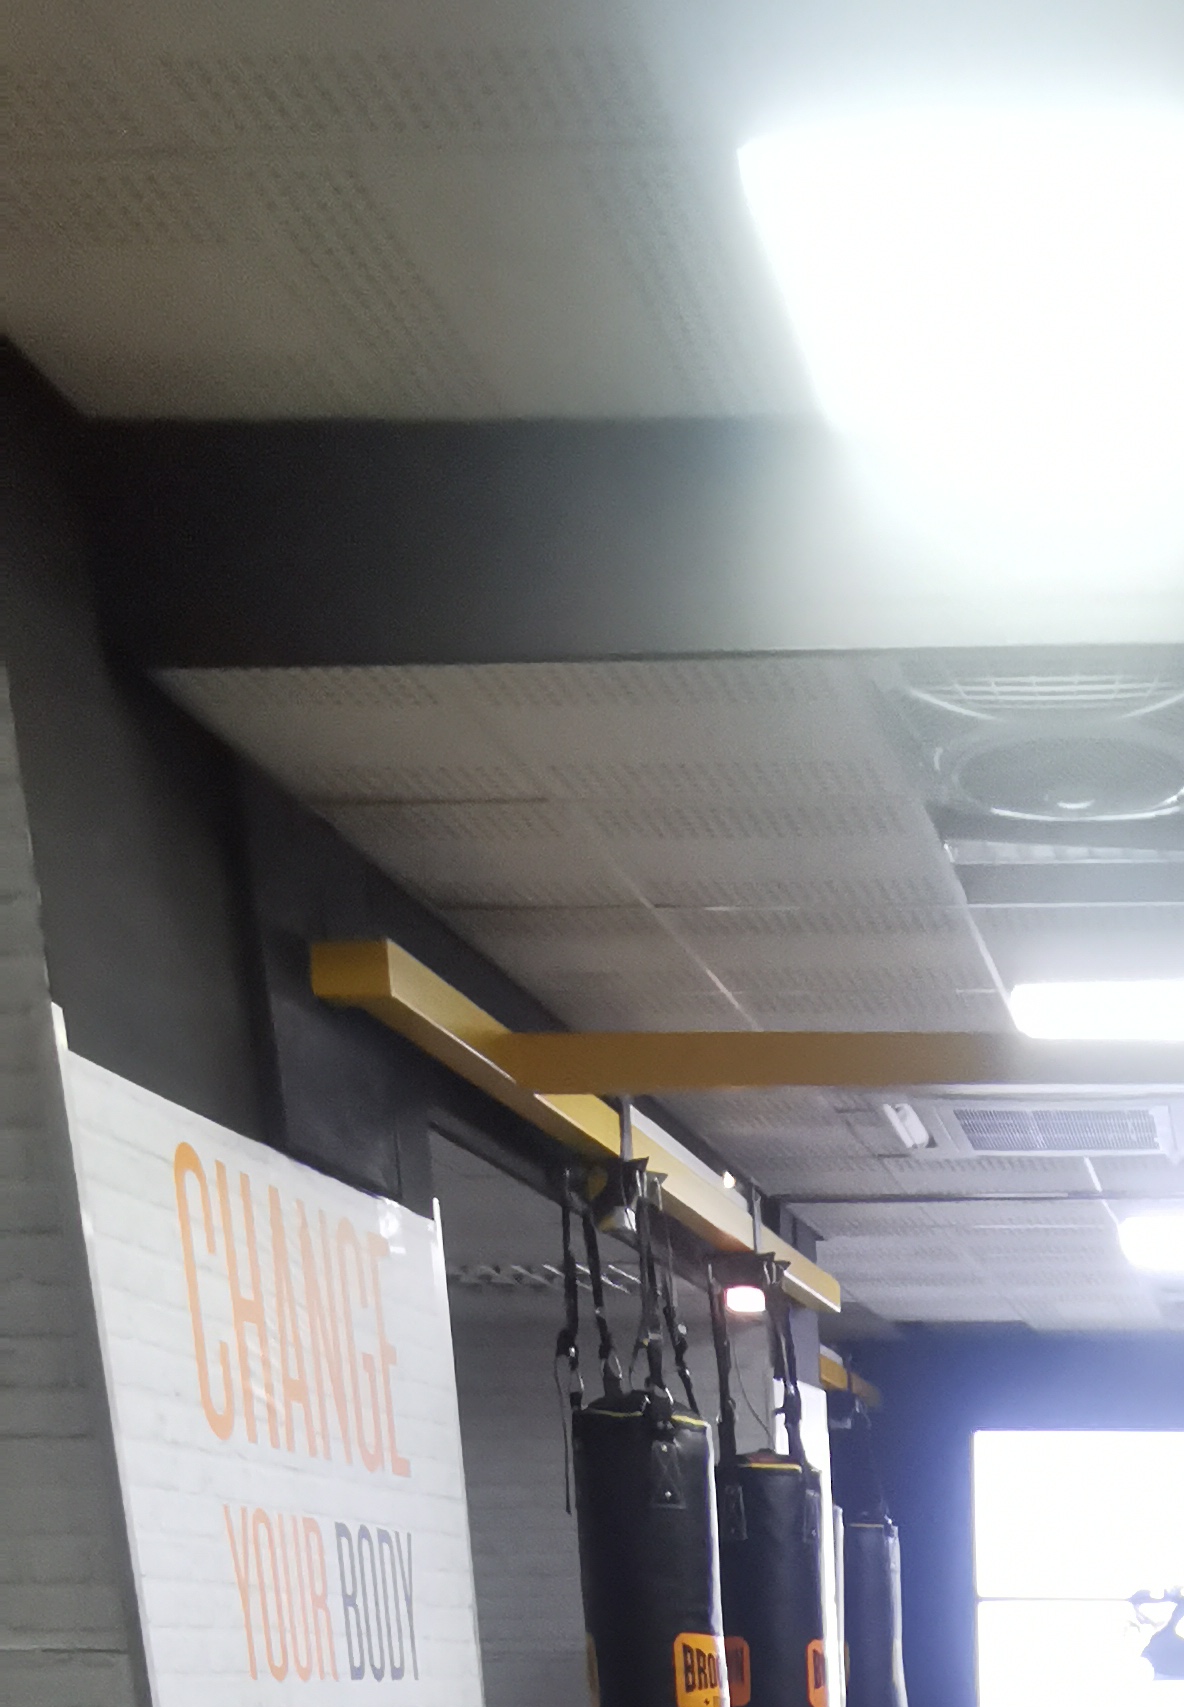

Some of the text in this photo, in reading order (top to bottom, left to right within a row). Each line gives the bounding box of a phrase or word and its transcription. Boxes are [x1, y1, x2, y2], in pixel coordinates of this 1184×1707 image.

[173, 1141, 411, 1478] CHANGE
[222, 1502, 420, 1684] YOUR BODY
